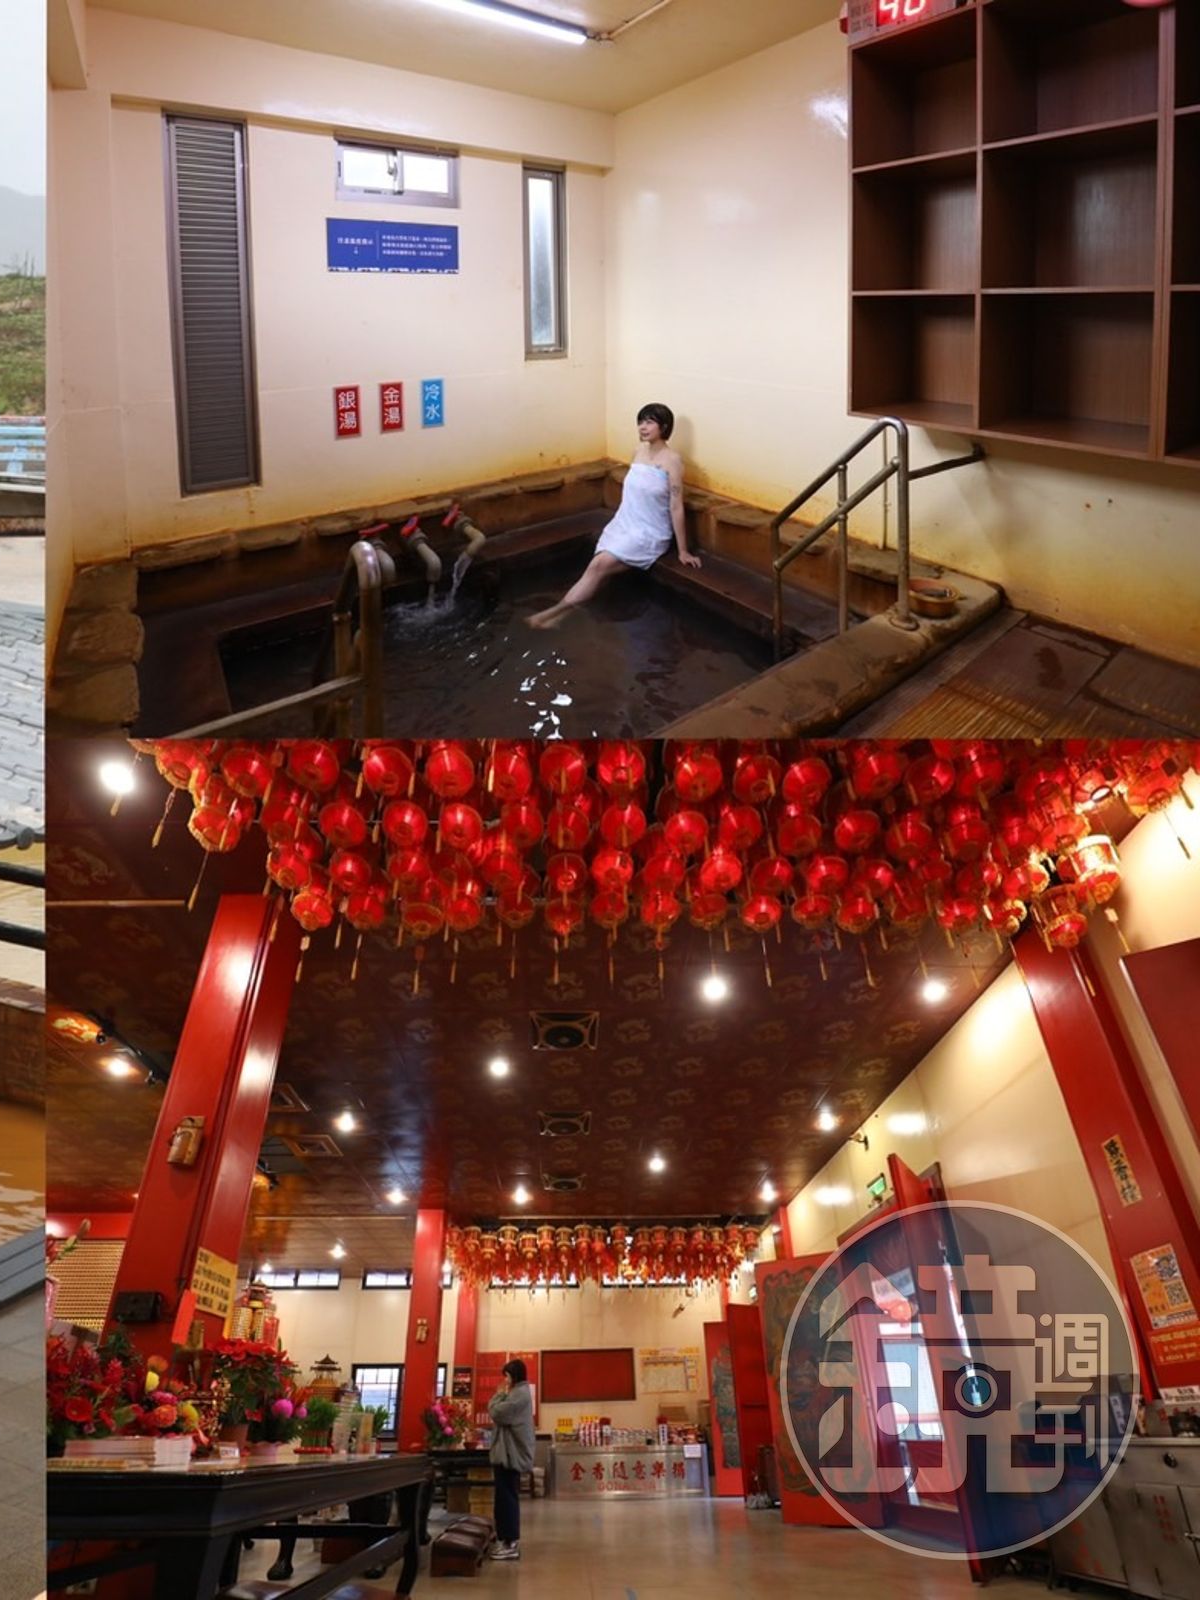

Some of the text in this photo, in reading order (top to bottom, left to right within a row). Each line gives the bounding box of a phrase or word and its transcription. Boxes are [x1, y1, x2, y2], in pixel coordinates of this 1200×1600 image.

[337, 390, 357, 430] 銀湯
[383, 386, 400, 425] 金湯
[424, 383, 440, 420] 冷水
